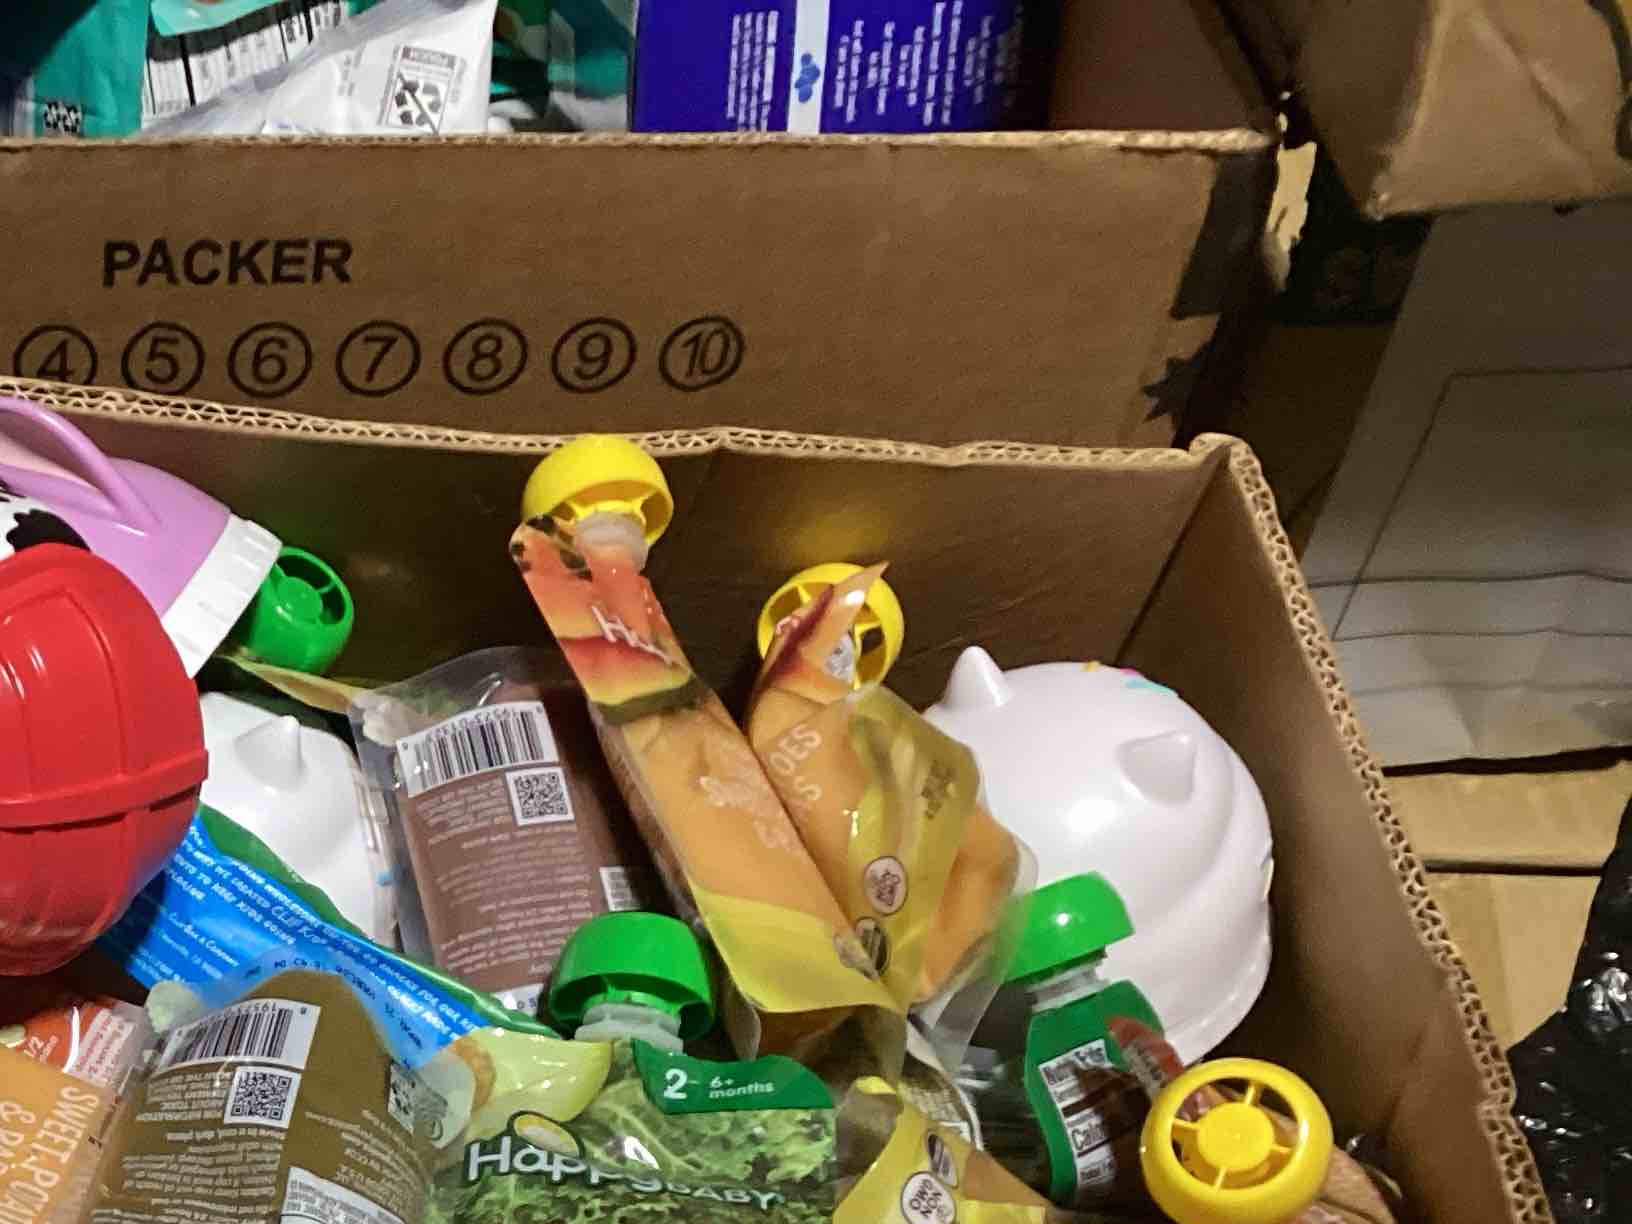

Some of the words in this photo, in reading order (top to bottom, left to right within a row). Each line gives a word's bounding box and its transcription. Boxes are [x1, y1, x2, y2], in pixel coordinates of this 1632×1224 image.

[102, 238, 352, 288] PACKER
[663, 1068, 689, 1100] 2
[708, 1081, 774, 1099] months
[39, 1085, 100, 1166] SWEET
